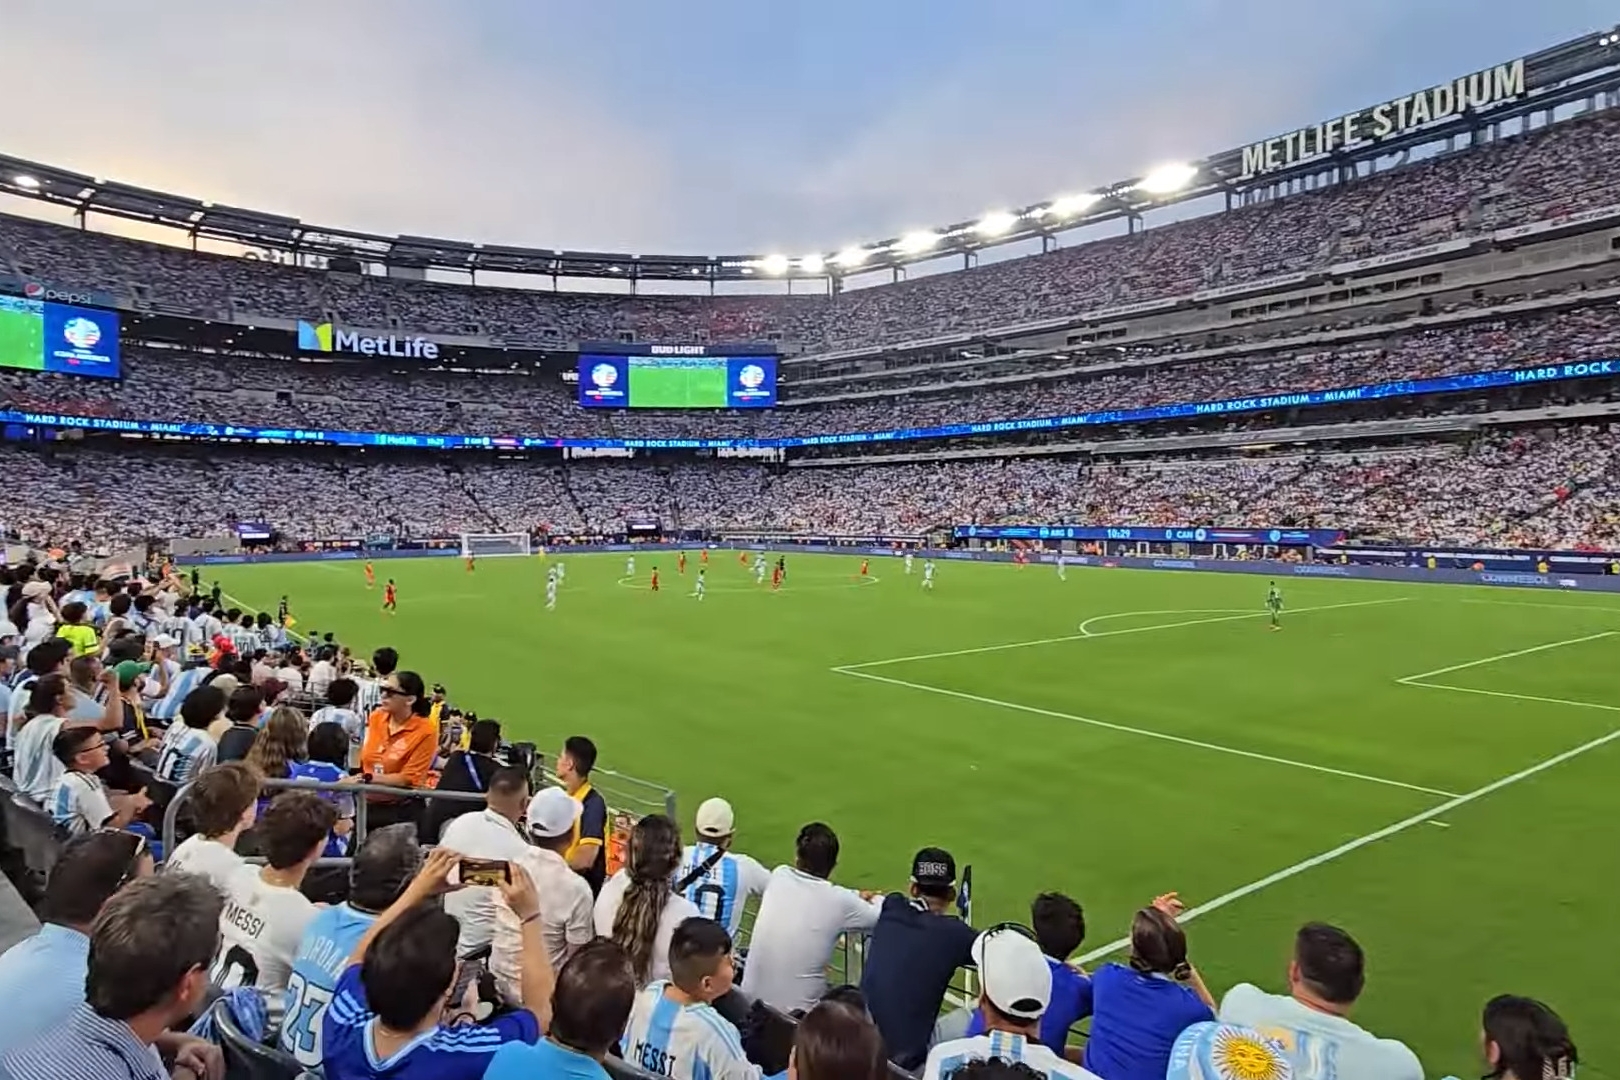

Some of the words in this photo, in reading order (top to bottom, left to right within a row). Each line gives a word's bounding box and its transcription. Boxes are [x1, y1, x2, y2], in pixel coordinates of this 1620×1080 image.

[1241, 113, 1361, 176] METLIFE
[1373, 58, 1524, 137] STADIUM
[45, 289, 92, 305] pepsi
[335, 330, 439, 359] MetLife
[651, 345, 673, 354] BUD
[674, 345, 705, 354] LIGHT
[1515, 367, 1557, 382] HARD
[1564, 361, 1611, 376] ROCK
[1196, 403, 1224, 413] HARD
[1227, 400, 1256, 411] ROCK
[1261, 394, 1310, 408] STADIUM
[1325, 388, 1361, 400] MIAMI
[25, 414, 56, 424] HARD
[60, 416, 90, 427] ROCK
[93, 419, 139, 430] STADIUM
[150, 424, 182, 432] MIAMI
[971, 423, 991, 432] HARD
[994, 421, 1015, 431] ROCK
[1018, 418, 1053, 429] STADIUM
[1062, 416, 1087, 425] MIAMI
[387, 436, 417, 445] MetLife
[802, 437, 819, 445] HARD
[820, 435, 837, 444] ROCK
[840, 433, 867, 442] STADIUM
[874, 431, 894, 440] MIAMI
[1107, 529, 1131, 538] 10:29
[1165, 529, 1172, 539] 0
[1176, 530, 1193, 539] CAN
[917, 861, 948, 876] BOSS
[225, 902, 265, 939] MESSI
[634, 1038, 676, 1078] MESSI
